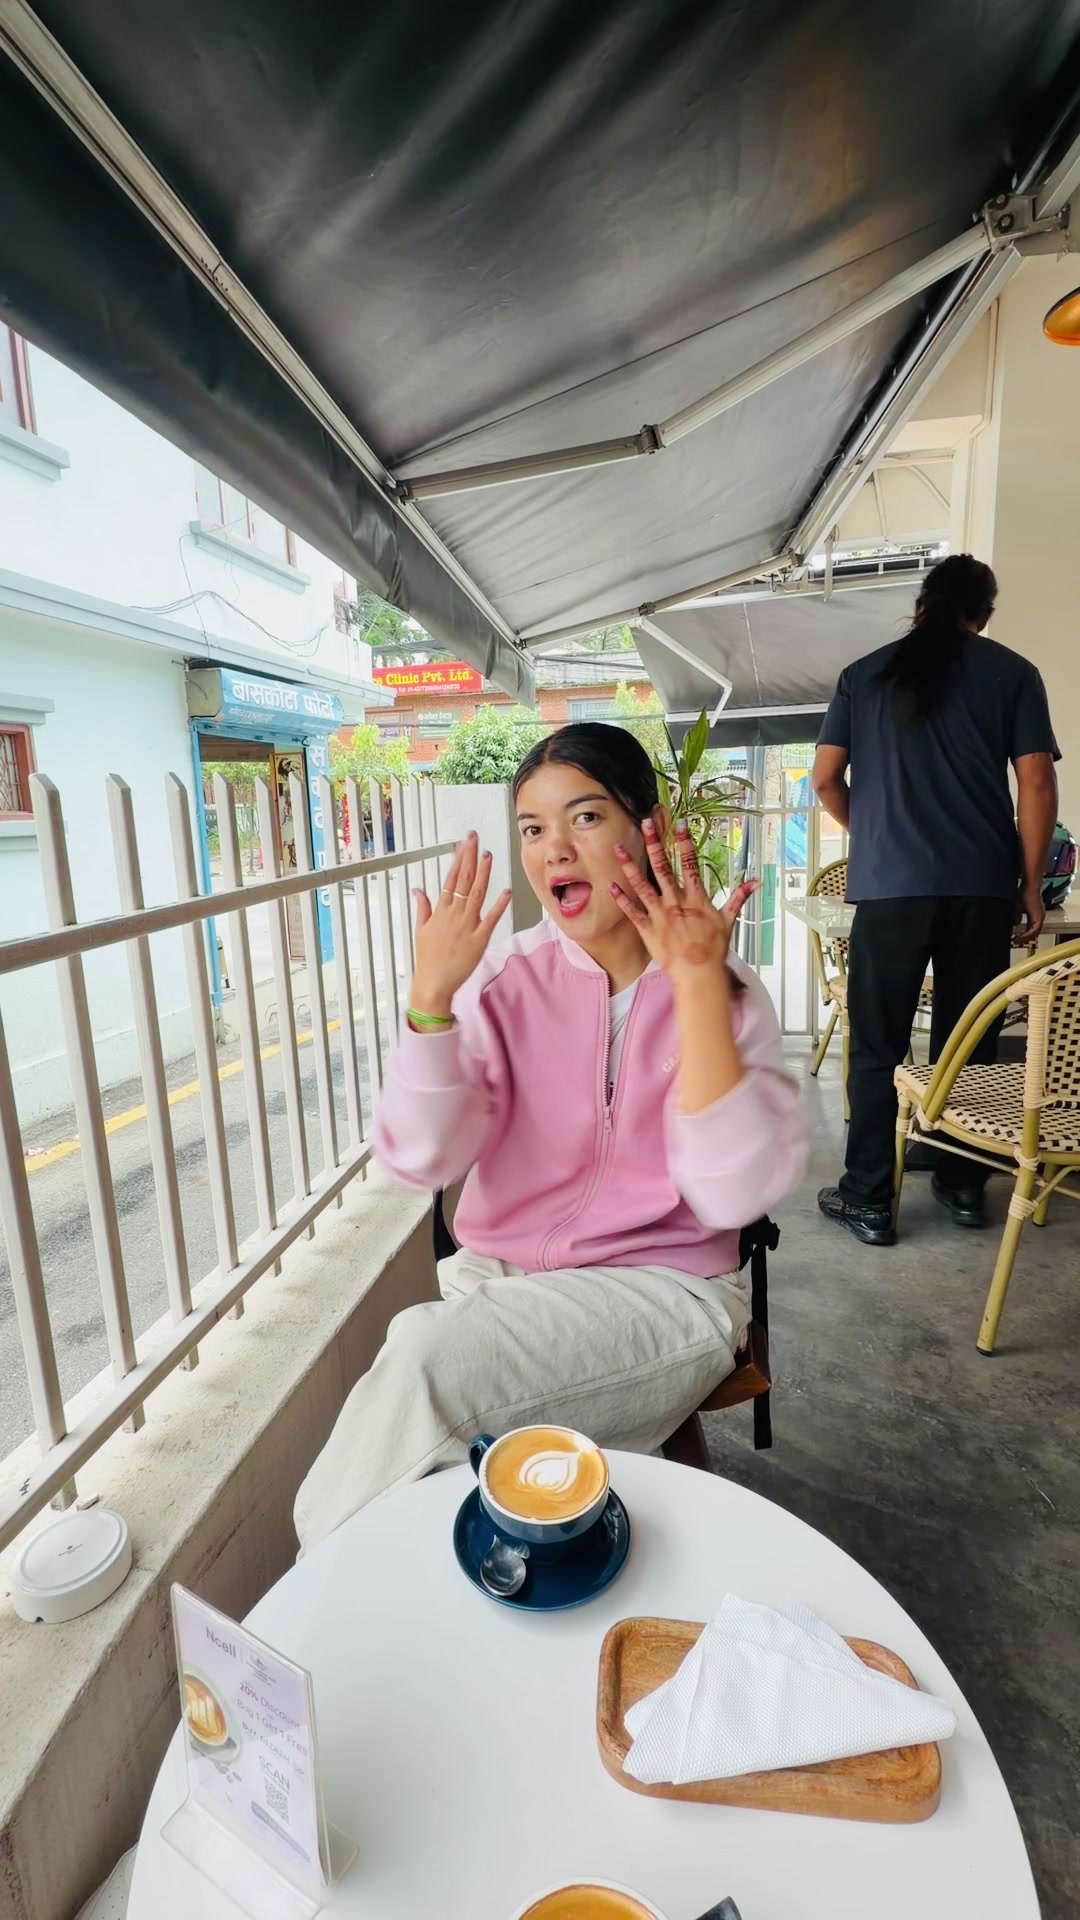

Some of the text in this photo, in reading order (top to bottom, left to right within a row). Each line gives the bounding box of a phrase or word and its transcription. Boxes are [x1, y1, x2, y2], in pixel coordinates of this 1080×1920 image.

[386, 672, 419, 685] Clinic
[422, 671, 446, 683] Pvt.
[449, 668, 473, 681] Ltd.
[231, 679, 299, 712] बासकोटा
[302, 691, 335, 719] फोटो
[206, 1626, 236, 1658] Ncell
[239, 1681, 300, 1729] 20% Discount
[237, 1698, 254, 1719] Buy
[262, 1717, 278, 1734] Get
[280, 1730, 284, 1738] 1
[287, 1734, 308, 1756] Free
[259, 1755, 290, 1791] SCAN
